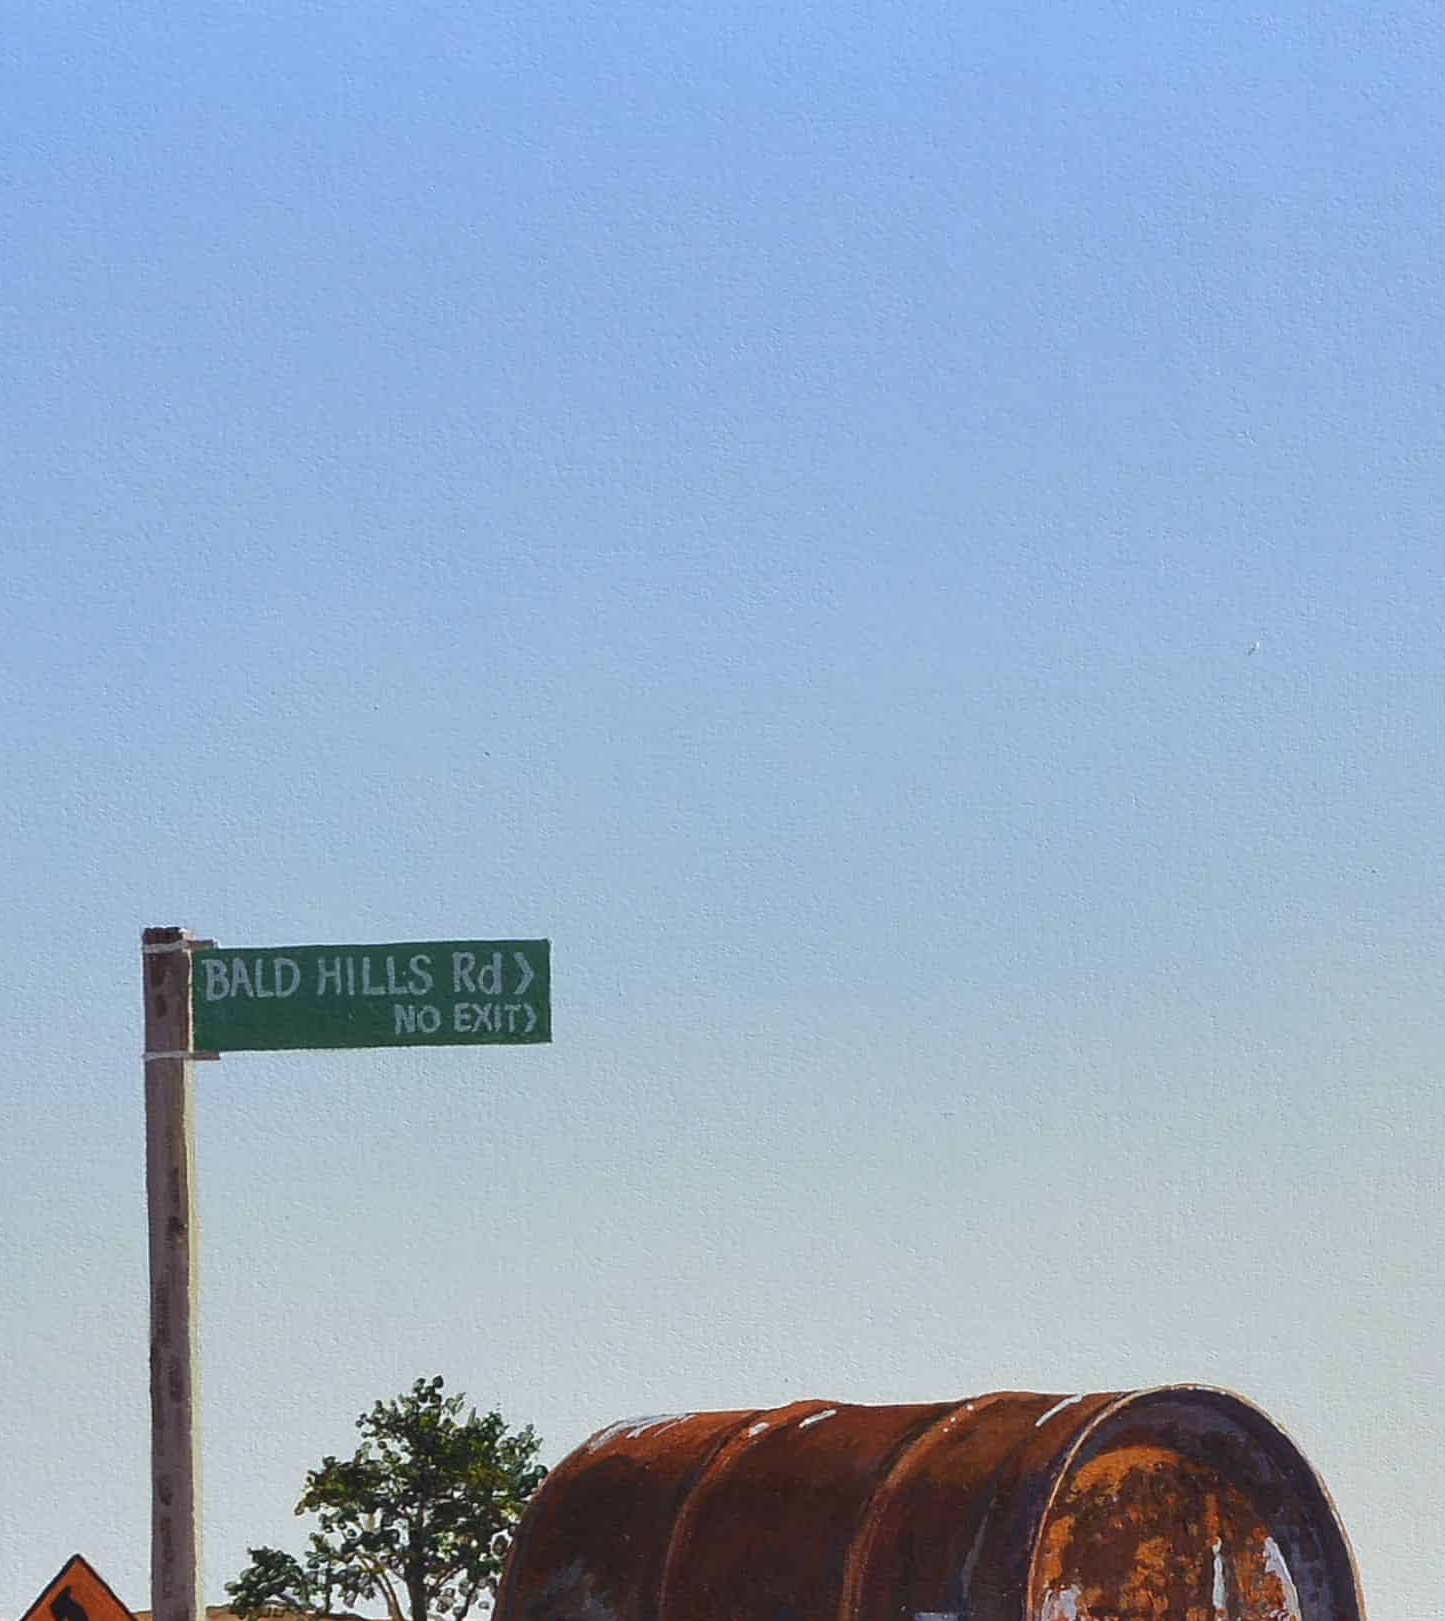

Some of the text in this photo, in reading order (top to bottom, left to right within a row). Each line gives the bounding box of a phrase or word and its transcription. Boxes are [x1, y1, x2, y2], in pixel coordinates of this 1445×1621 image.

[202, 952, 503, 1000] BALD HILLS Rd
[394, 1002, 522, 1034] NO EXIT
